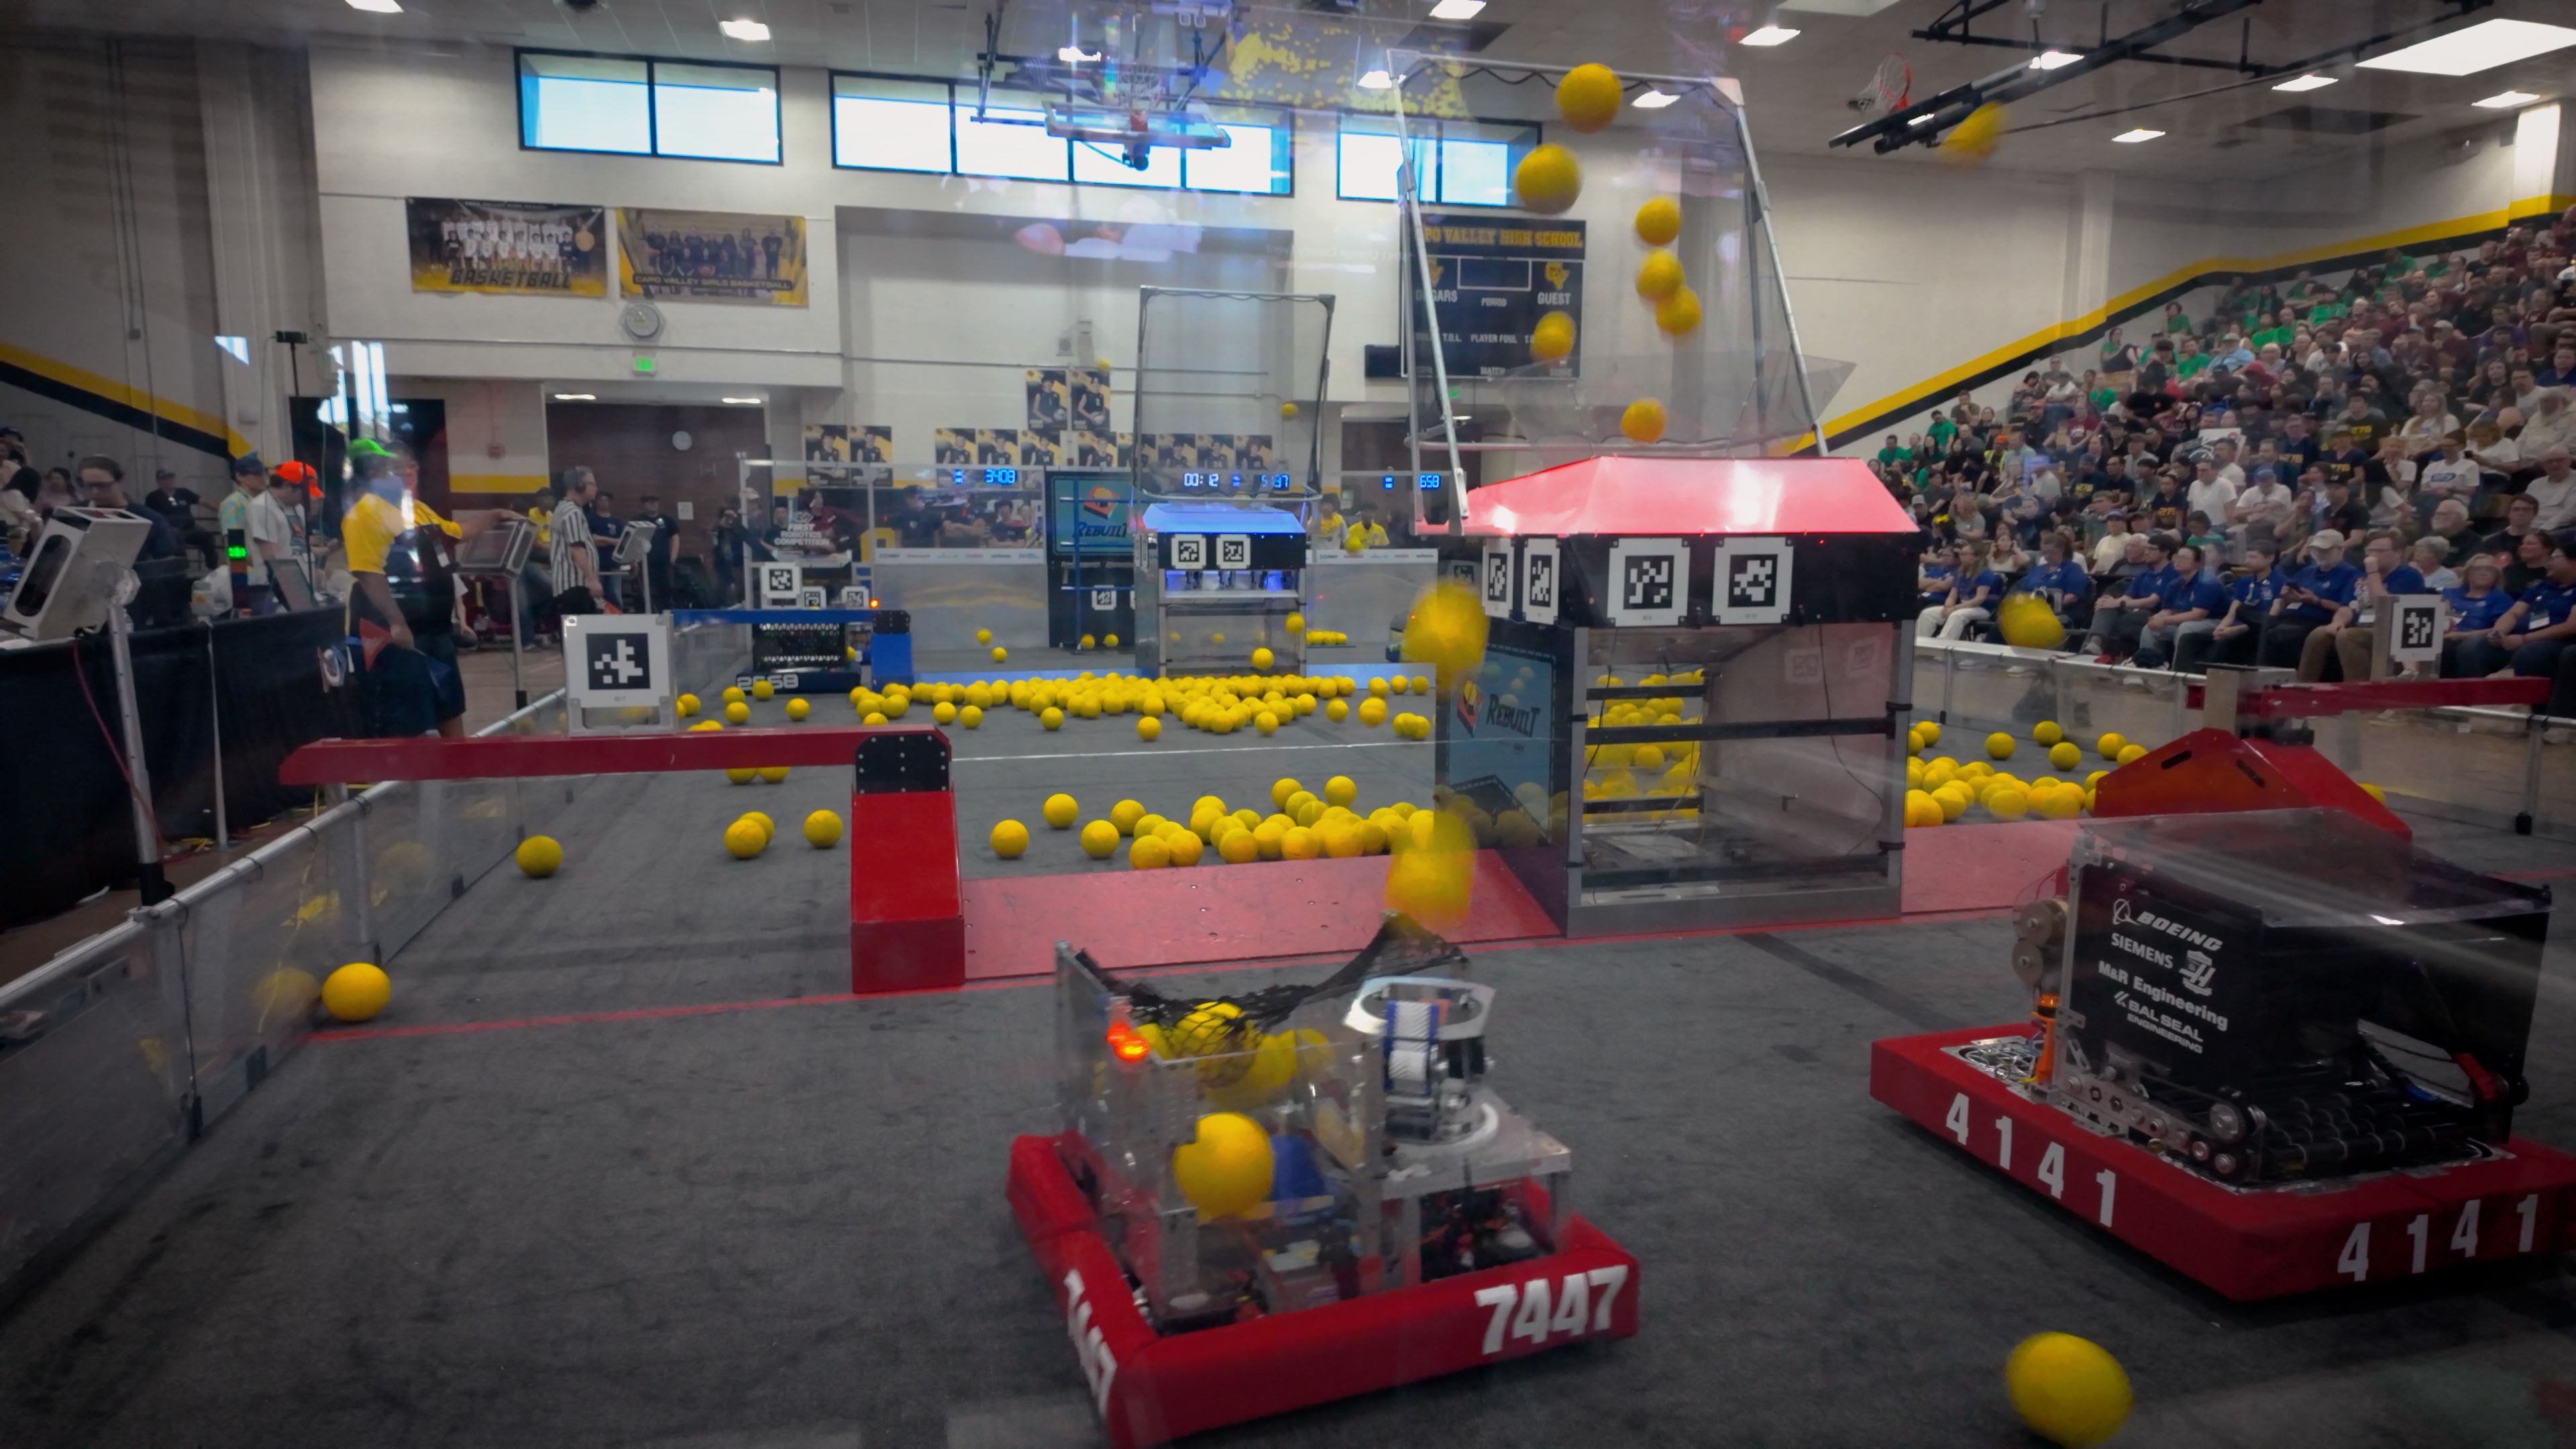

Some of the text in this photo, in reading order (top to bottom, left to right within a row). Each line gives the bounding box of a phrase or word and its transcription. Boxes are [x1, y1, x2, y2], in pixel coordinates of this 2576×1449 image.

[1423, 227, 1584, 248] PO VALLEY HIGH SCHOOL
[450, 268, 570, 288] BASKETBALL
[635, 275, 662, 284] CAPO
[663, 277, 698, 285] VALLEY
[731, 279, 790, 289] BASKETBALL
[1481, 297, 1507, 307] PERIOD
[1537, 292, 1572, 305] GUEST
[1470, 334, 1517, 343] PLAYER FOUL
[1481, 366, 1505, 376] MATCH
[985, 469, 1016, 484] 3408
[1184, 473, 1219, 487] 00:12
[1419, 475, 1440, 488] 658
[780, 531, 822, 539] ROBOTICS
[788, 523, 815, 531] FIRST
[773, 537, 830, 545] COMPETITION
[1486, 693, 1541, 738] REBUILT
[2137, 911, 2223, 951] BOEING
[2111, 932, 2174, 969] SIEMENS
[2098, 960, 2228, 1031] M&R Engineering
[2129, 1000, 2204, 1042] BAL SEAL
[2127, 1013, 2203, 1054] ENGINEERING
[1946, 1092, 2116, 1228] 4141
[2337, 1194, 2538, 1282] 4141
[1474, 1264, 1629, 1355] 7447
